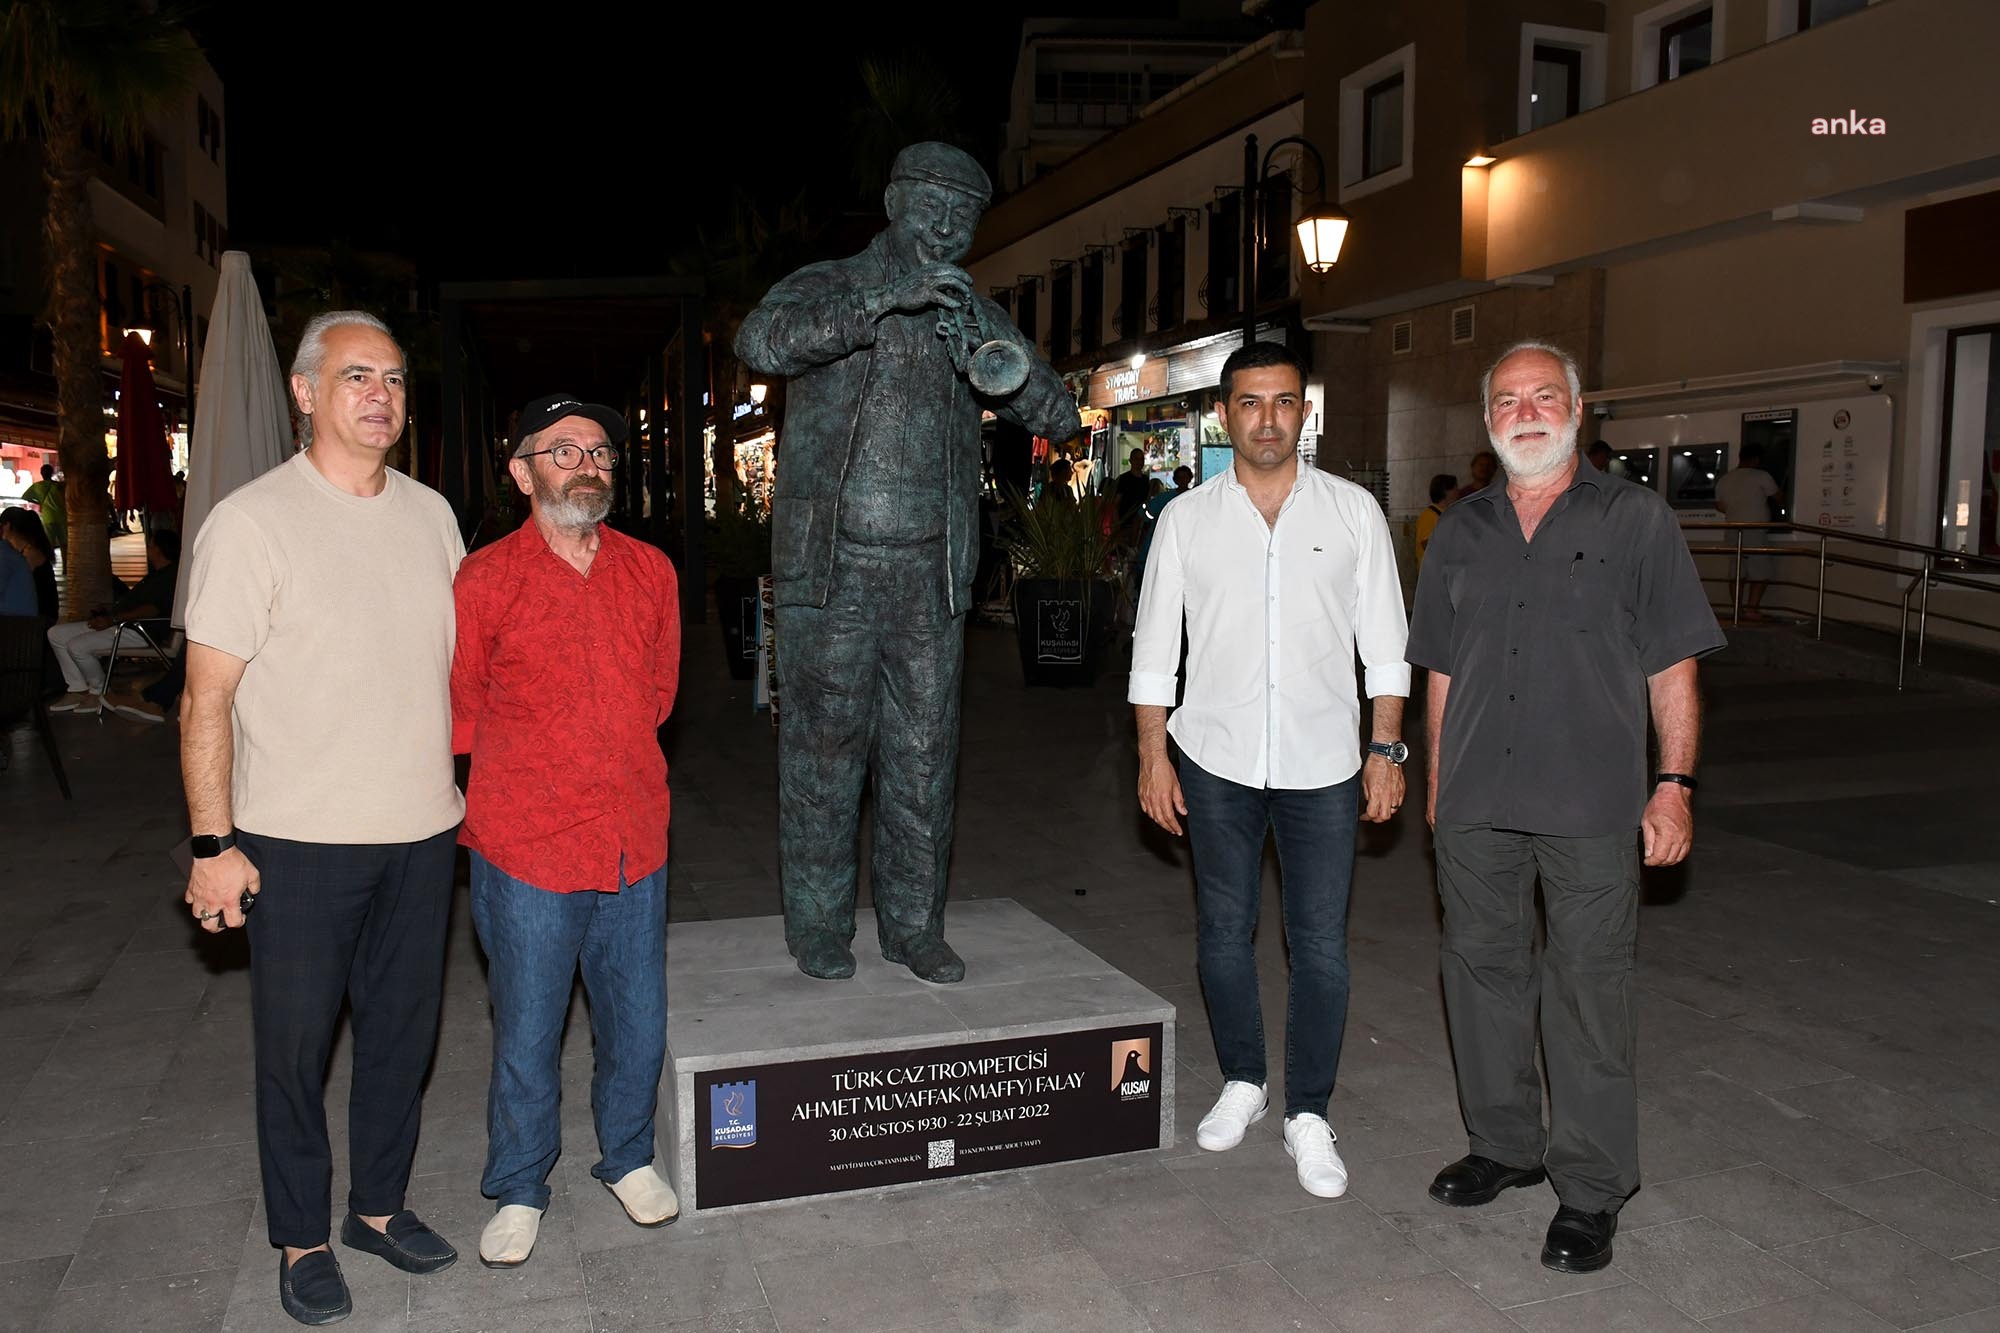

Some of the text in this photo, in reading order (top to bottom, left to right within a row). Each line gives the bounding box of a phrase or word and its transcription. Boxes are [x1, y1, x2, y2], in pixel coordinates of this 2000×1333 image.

[1105, 369, 1140, 390] SYMPHONY
[1114, 385, 1138, 403] TRAVEL
[831, 1048, 1048, 1091] TÜRK CAZ TROMPETCİSİ
[791, 1071, 1086, 1121] AHMET MUVAFFAK (MAFFY) FALAY
[1121, 1080, 1150, 1096] KUSAV
[828, 1128, 847, 1142] 30
[849, 1119, 915, 1140] AĞUSTOS
[918, 1116, 947, 1132] 1930
[957, 1113, 973, 1127] 22
[975, 1107, 1016, 1127] ŞUBAT
[1018, 1103, 1050, 1119] 2022
